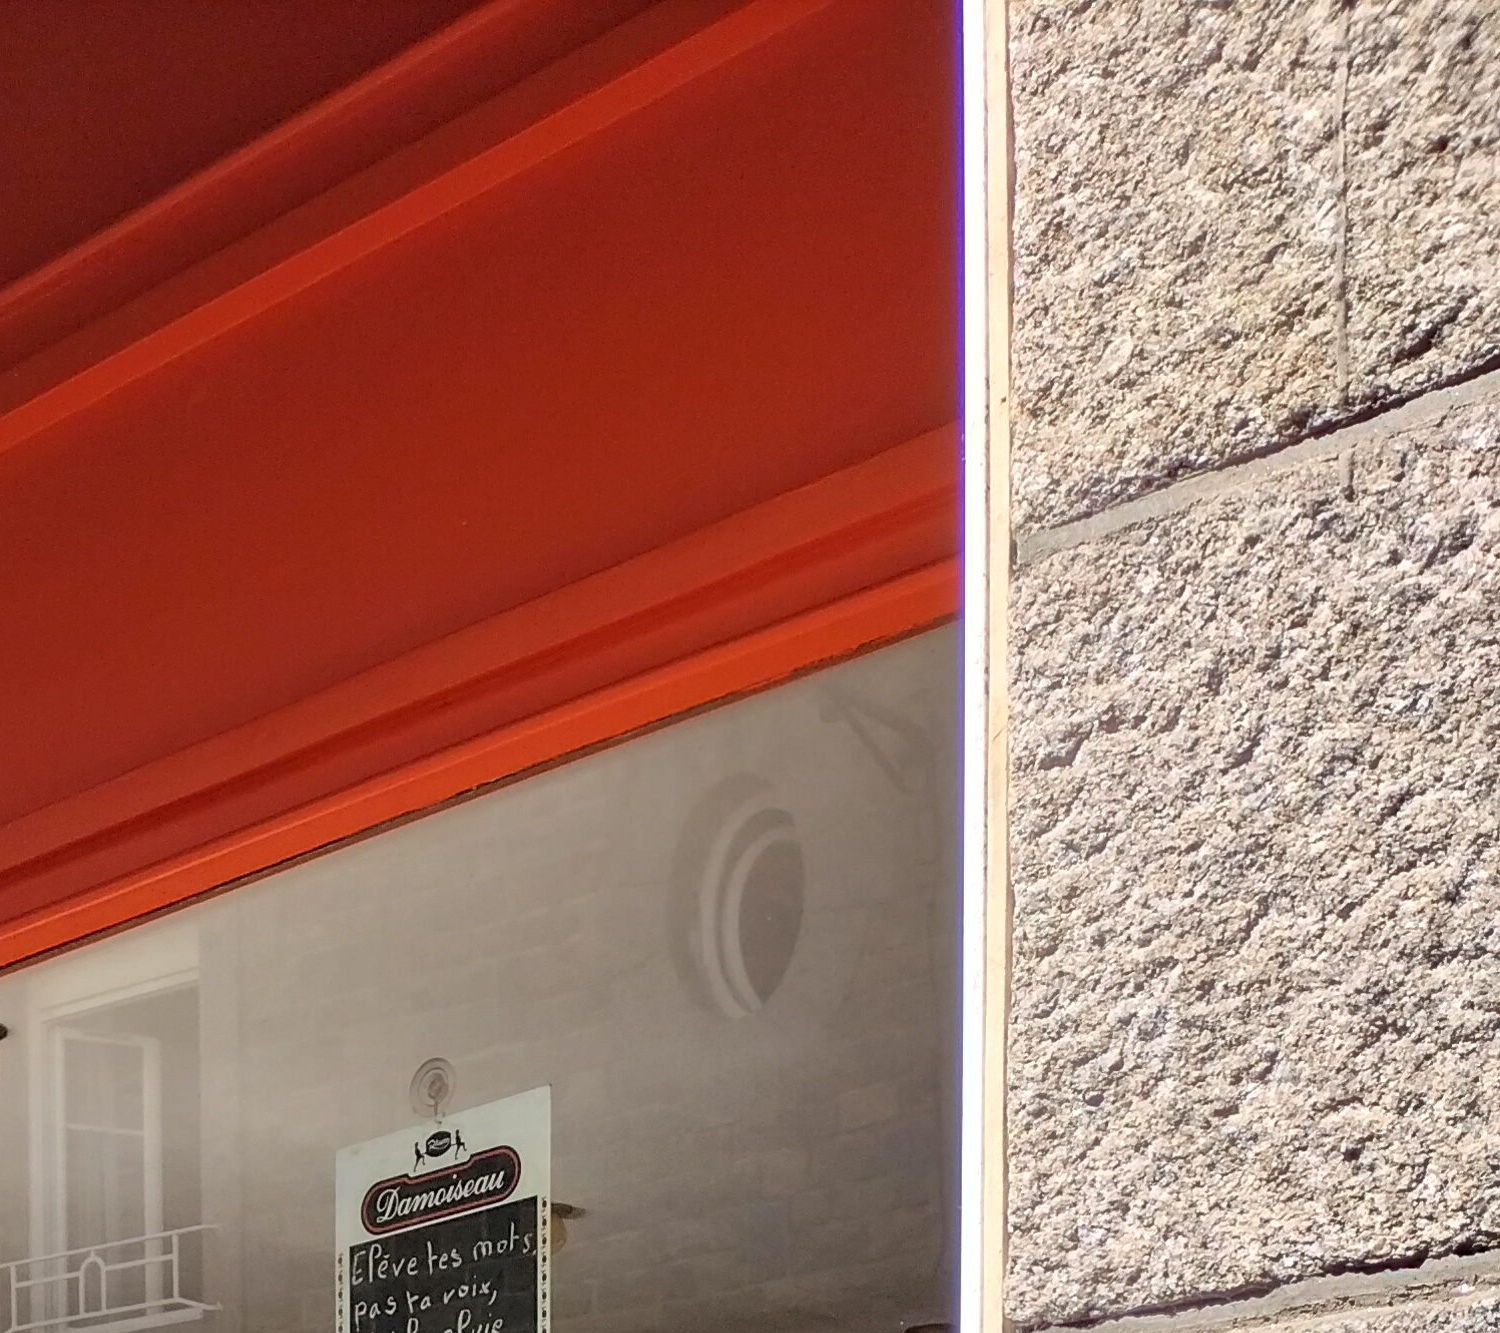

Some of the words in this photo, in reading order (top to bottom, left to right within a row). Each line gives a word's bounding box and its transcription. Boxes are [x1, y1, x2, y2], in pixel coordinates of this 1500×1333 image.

[376, 1170, 505, 1223] Damoiseau
[427, 1241, 463, 1275] tes
[355, 1296, 397, 1332] pas
[406, 1291, 431, 1313] ta
[443, 1275, 497, 1305] voix,
